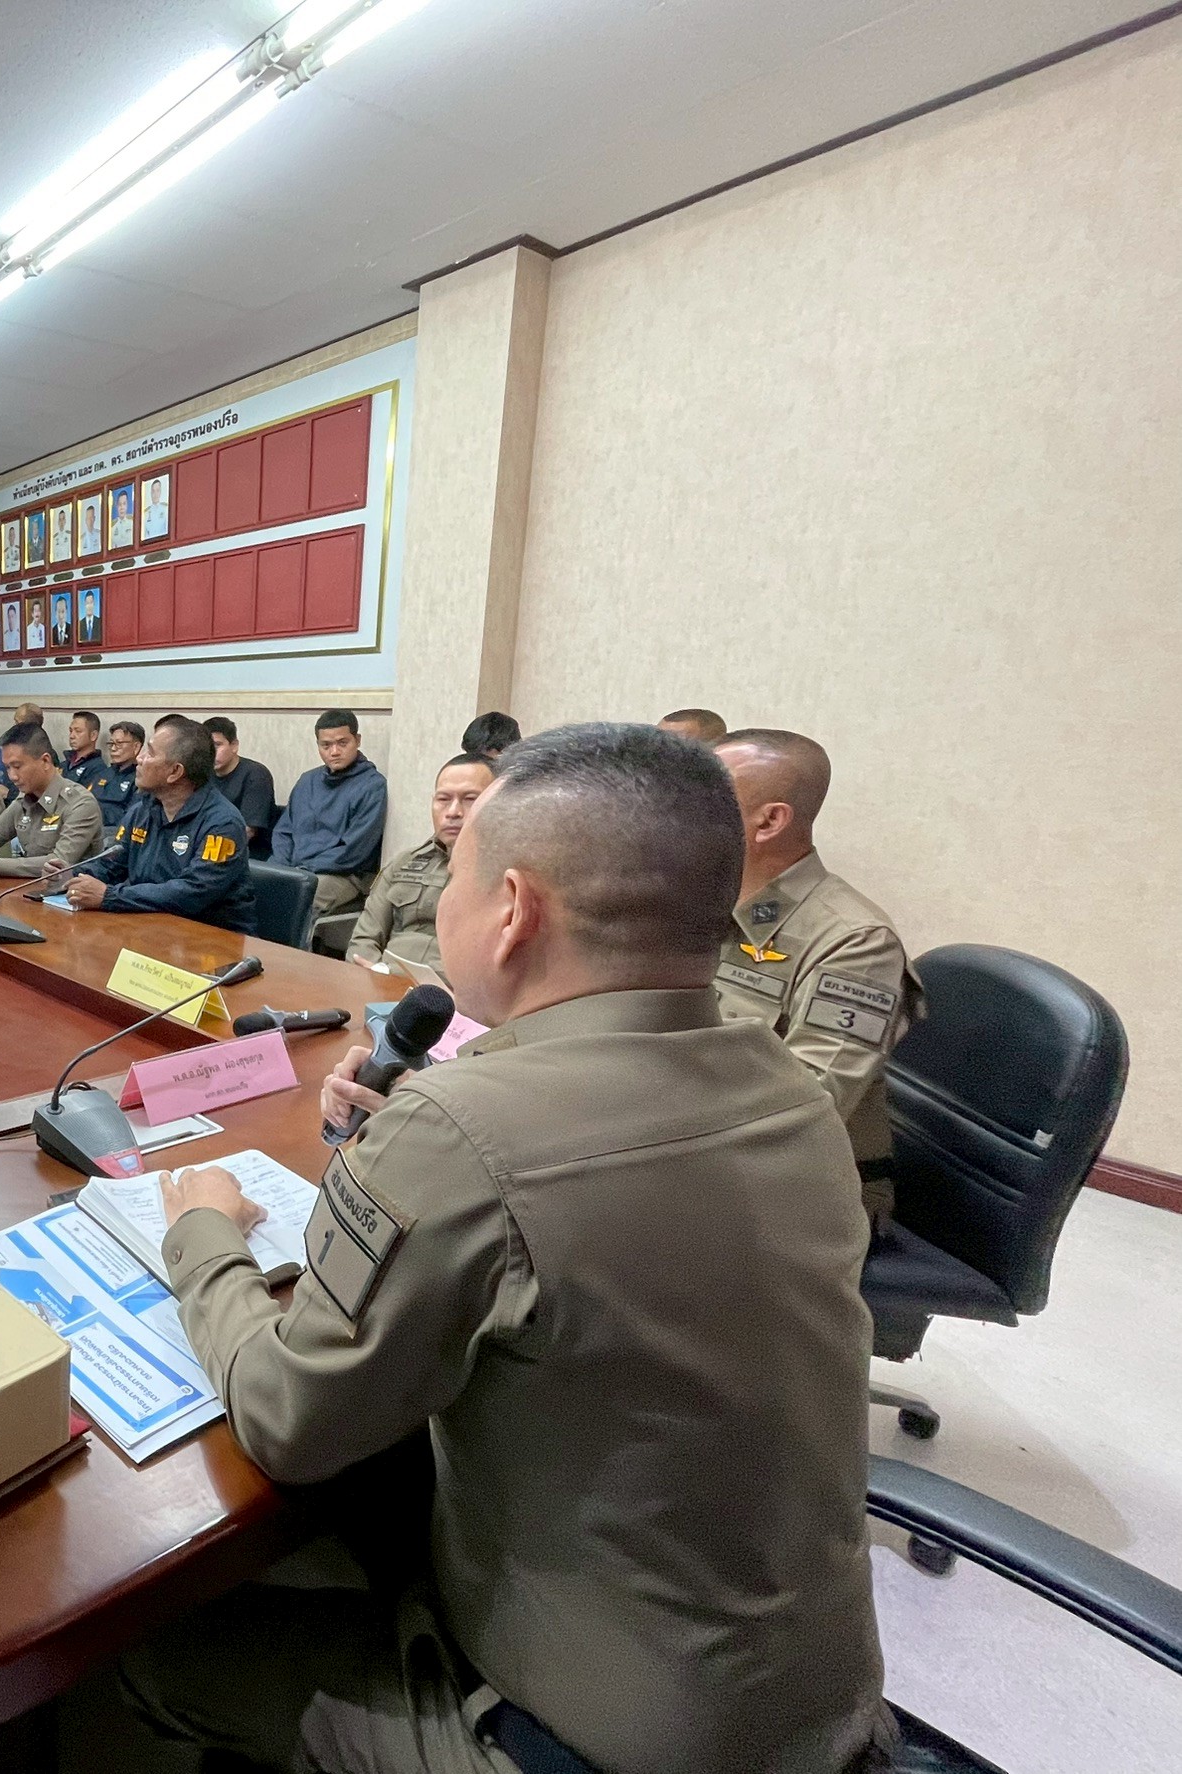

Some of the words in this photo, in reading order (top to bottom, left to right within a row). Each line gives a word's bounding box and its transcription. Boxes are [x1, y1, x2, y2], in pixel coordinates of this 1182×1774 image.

[12, 471, 77, 500] ทำเนียบผู้บังคับบัญชา
[78, 466, 93, 478] และ
[111, 454, 124, 467] ตร.
[125, 409, 239, 461] สถานีตำรวจภูธรหนองปรือ
[202, 834, 237, 863] NP
[823, 979, 891, 1006] สภ.หนองปรือ
[836, 1008, 855, 1029] 3
[318, 1229, 335, 1266] 1
[108, 1344, 152, 1380] สภ.หนองปรือ
